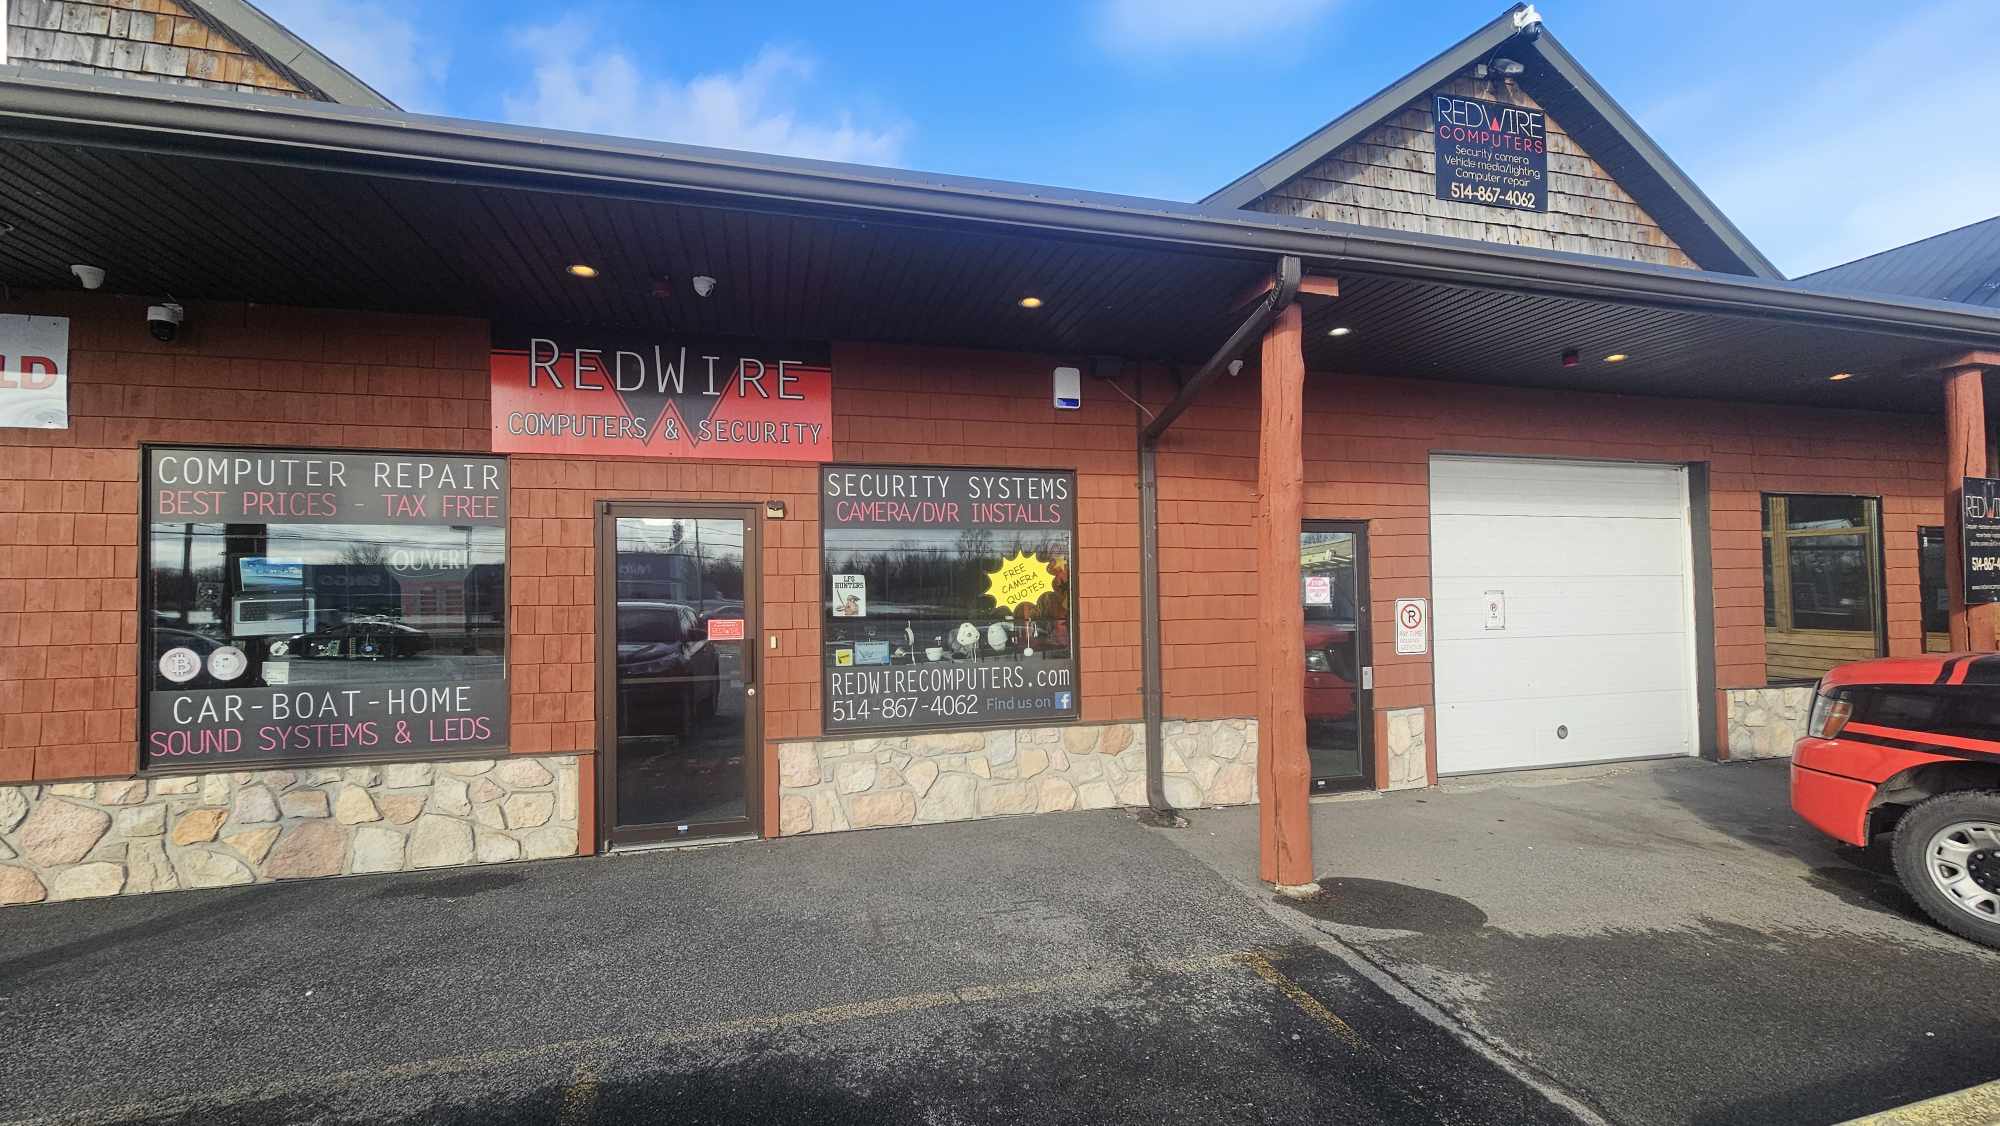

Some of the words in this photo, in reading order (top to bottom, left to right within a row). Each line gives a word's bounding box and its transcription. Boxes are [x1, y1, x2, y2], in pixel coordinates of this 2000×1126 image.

[1437, 96, 1544, 139] REDWIRE
[1439, 125, 1543, 154] COMPUTERS
[1444, 154, 1476, 166] Vehicle
[1477, 160, 1541, 180] media/lighting
[1456, 144, 1493, 161] Security
[1494, 153, 1529, 165] camera
[1455, 167, 1501, 183] Computer
[1503, 177, 1531, 187] repair
[1451, 182, 1536, 208] 514-867-4062
[529, 338, 805, 400] REDWIRE
[508, 412, 648, 440] COMPUTERS
[664, 418, 680, 440] &
[698, 419, 823, 445] SECURITY
[158, 456, 347, 488] COMPUTER
[373, 461, 500, 490] REPAIR
[828, 473, 951, 498] SECURITY
[968, 475, 1068, 500] SYSTEMS
[159, 490, 227, 516] BEST
[242, 491, 337, 518] PRICES
[381, 494, 426, 518] TAX
[443, 494, 499, 519] FREE
[836, 501, 960, 523] CAMERA/DVR
[971, 503, 1061, 523] INSTALLS
[391, 549, 470, 571] OUVERT
[1003, 563, 1026, 580] FREE
[1002, 571, 1038, 594] CAMERA
[1007, 580, 1045, 605] QUOTES
[832, 666, 1070, 696] REDWIRECOMPUTERS.com
[832, 694, 979, 721] 514-867-4062
[986, 696, 1015, 711] Find
[1017, 698, 1033, 709] us
[1034, 697, 1051, 708] on
[150, 728, 242, 757] SOUND
[259, 721, 379, 752] SYSTEMS
[394, 720, 412, 745] &
[429, 717, 491, 743] LEDS
